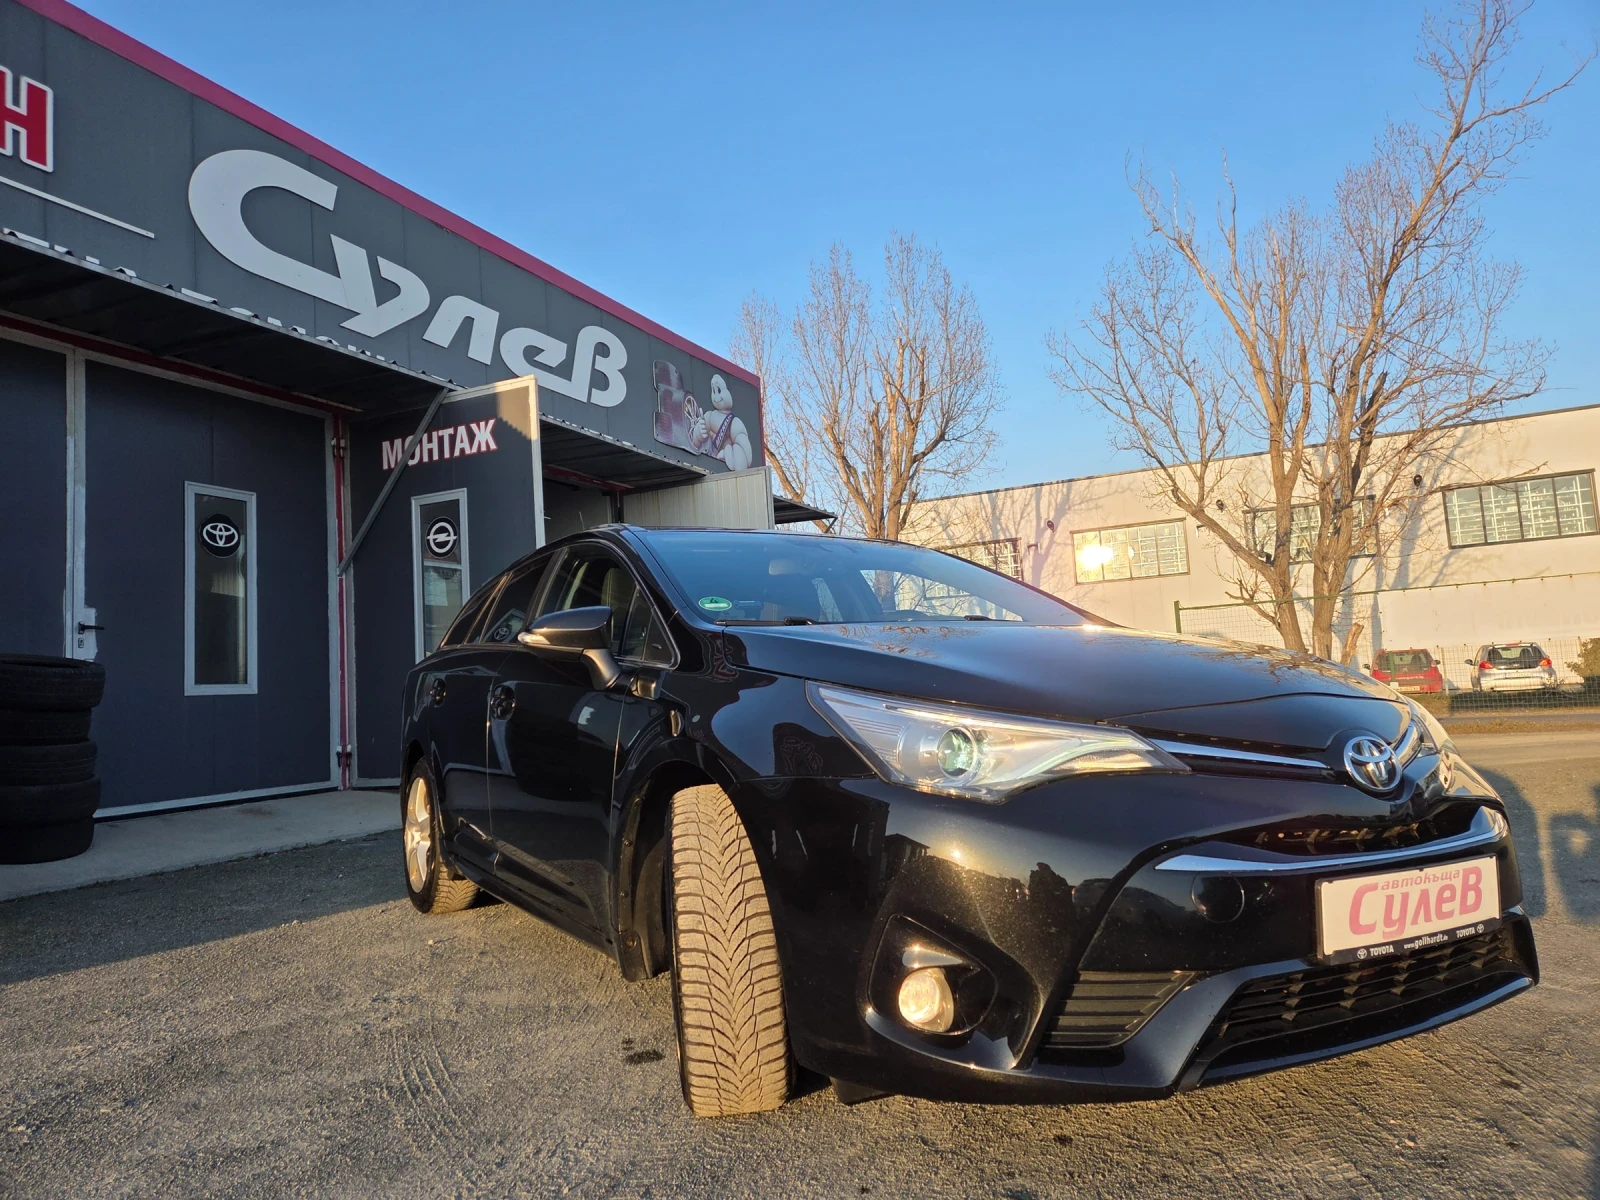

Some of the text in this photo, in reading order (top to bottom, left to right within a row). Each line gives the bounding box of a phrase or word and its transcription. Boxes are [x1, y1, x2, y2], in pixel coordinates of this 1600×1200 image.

[1381, 869, 1460, 891] автокъща
[1370, 945, 1394, 956] TOYOTA
[1456, 926, 1475, 938] TOYOTA
